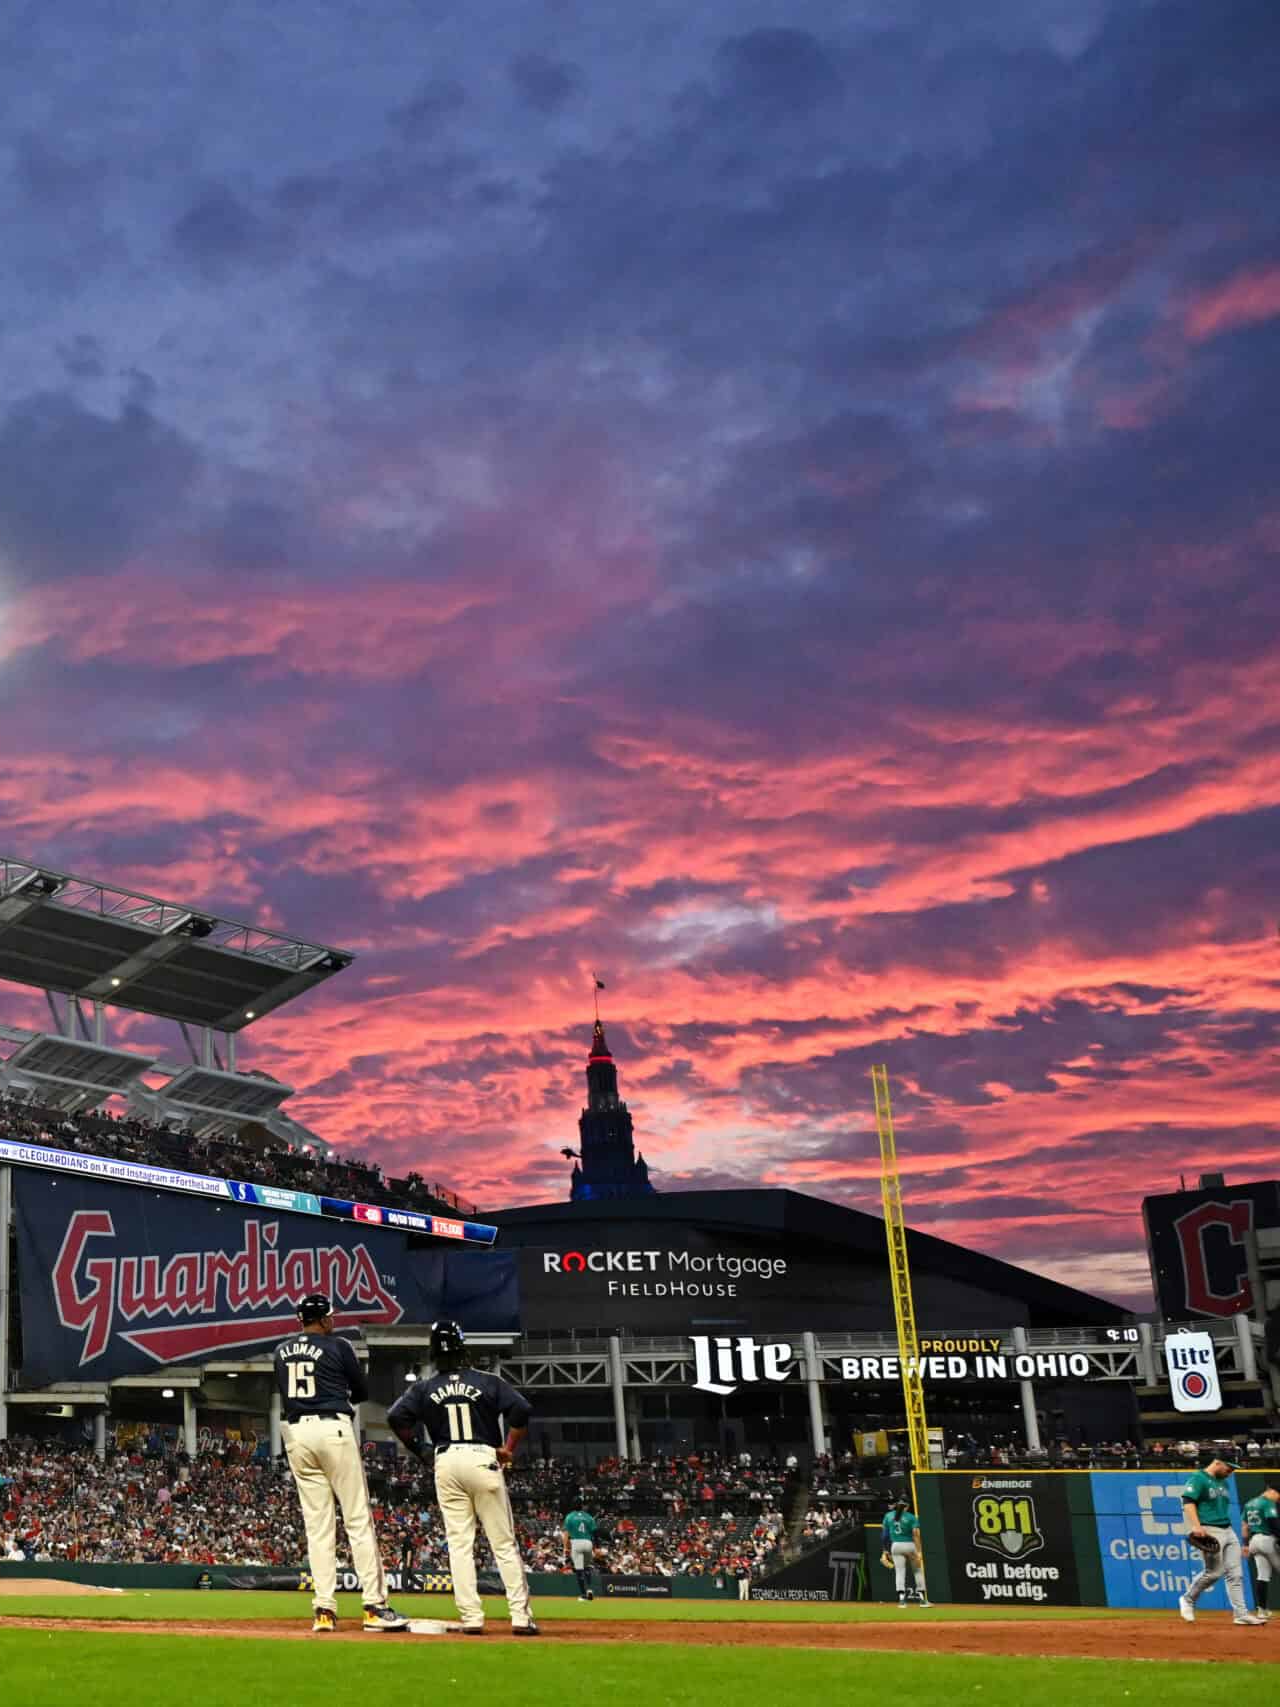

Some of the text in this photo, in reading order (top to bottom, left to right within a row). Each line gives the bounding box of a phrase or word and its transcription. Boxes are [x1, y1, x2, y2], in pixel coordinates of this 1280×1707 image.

[90, 1162, 100, 1171] on
[102, 1163, 108, 1172] X
[110, 1166, 125, 1176] and
[127, 1167, 167, 1182] Instagram
[543, 1251, 787, 1279] ROCKET Mortgage
[1173, 1199, 1256, 1320] C
[52, 1210, 386, 1367] Guardians
[279, 1344, 325, 1361] ALOMAR
[921, 1339, 1001, 1353] PROUDLY
[688, 1336, 792, 1395] Lite
[841, 1353, 1090, 1380] BREWED IN OHIO
[1170, 1347, 1210, 1371] Lite
[286, 1361, 316, 1398] 15
[444, 1403, 473, 1441] 11
[578, 1522, 585, 1534] 4
[894, 1521, 903, 1535] 3
[978, 1499, 1033, 1534] 811
[1110, 1539, 1204, 1561] Clevela
[965, 1562, 1059, 1580] Call before
[1141, 1570, 1214, 1592] Clin
[982, 1582, 1048, 1601] you dig.
